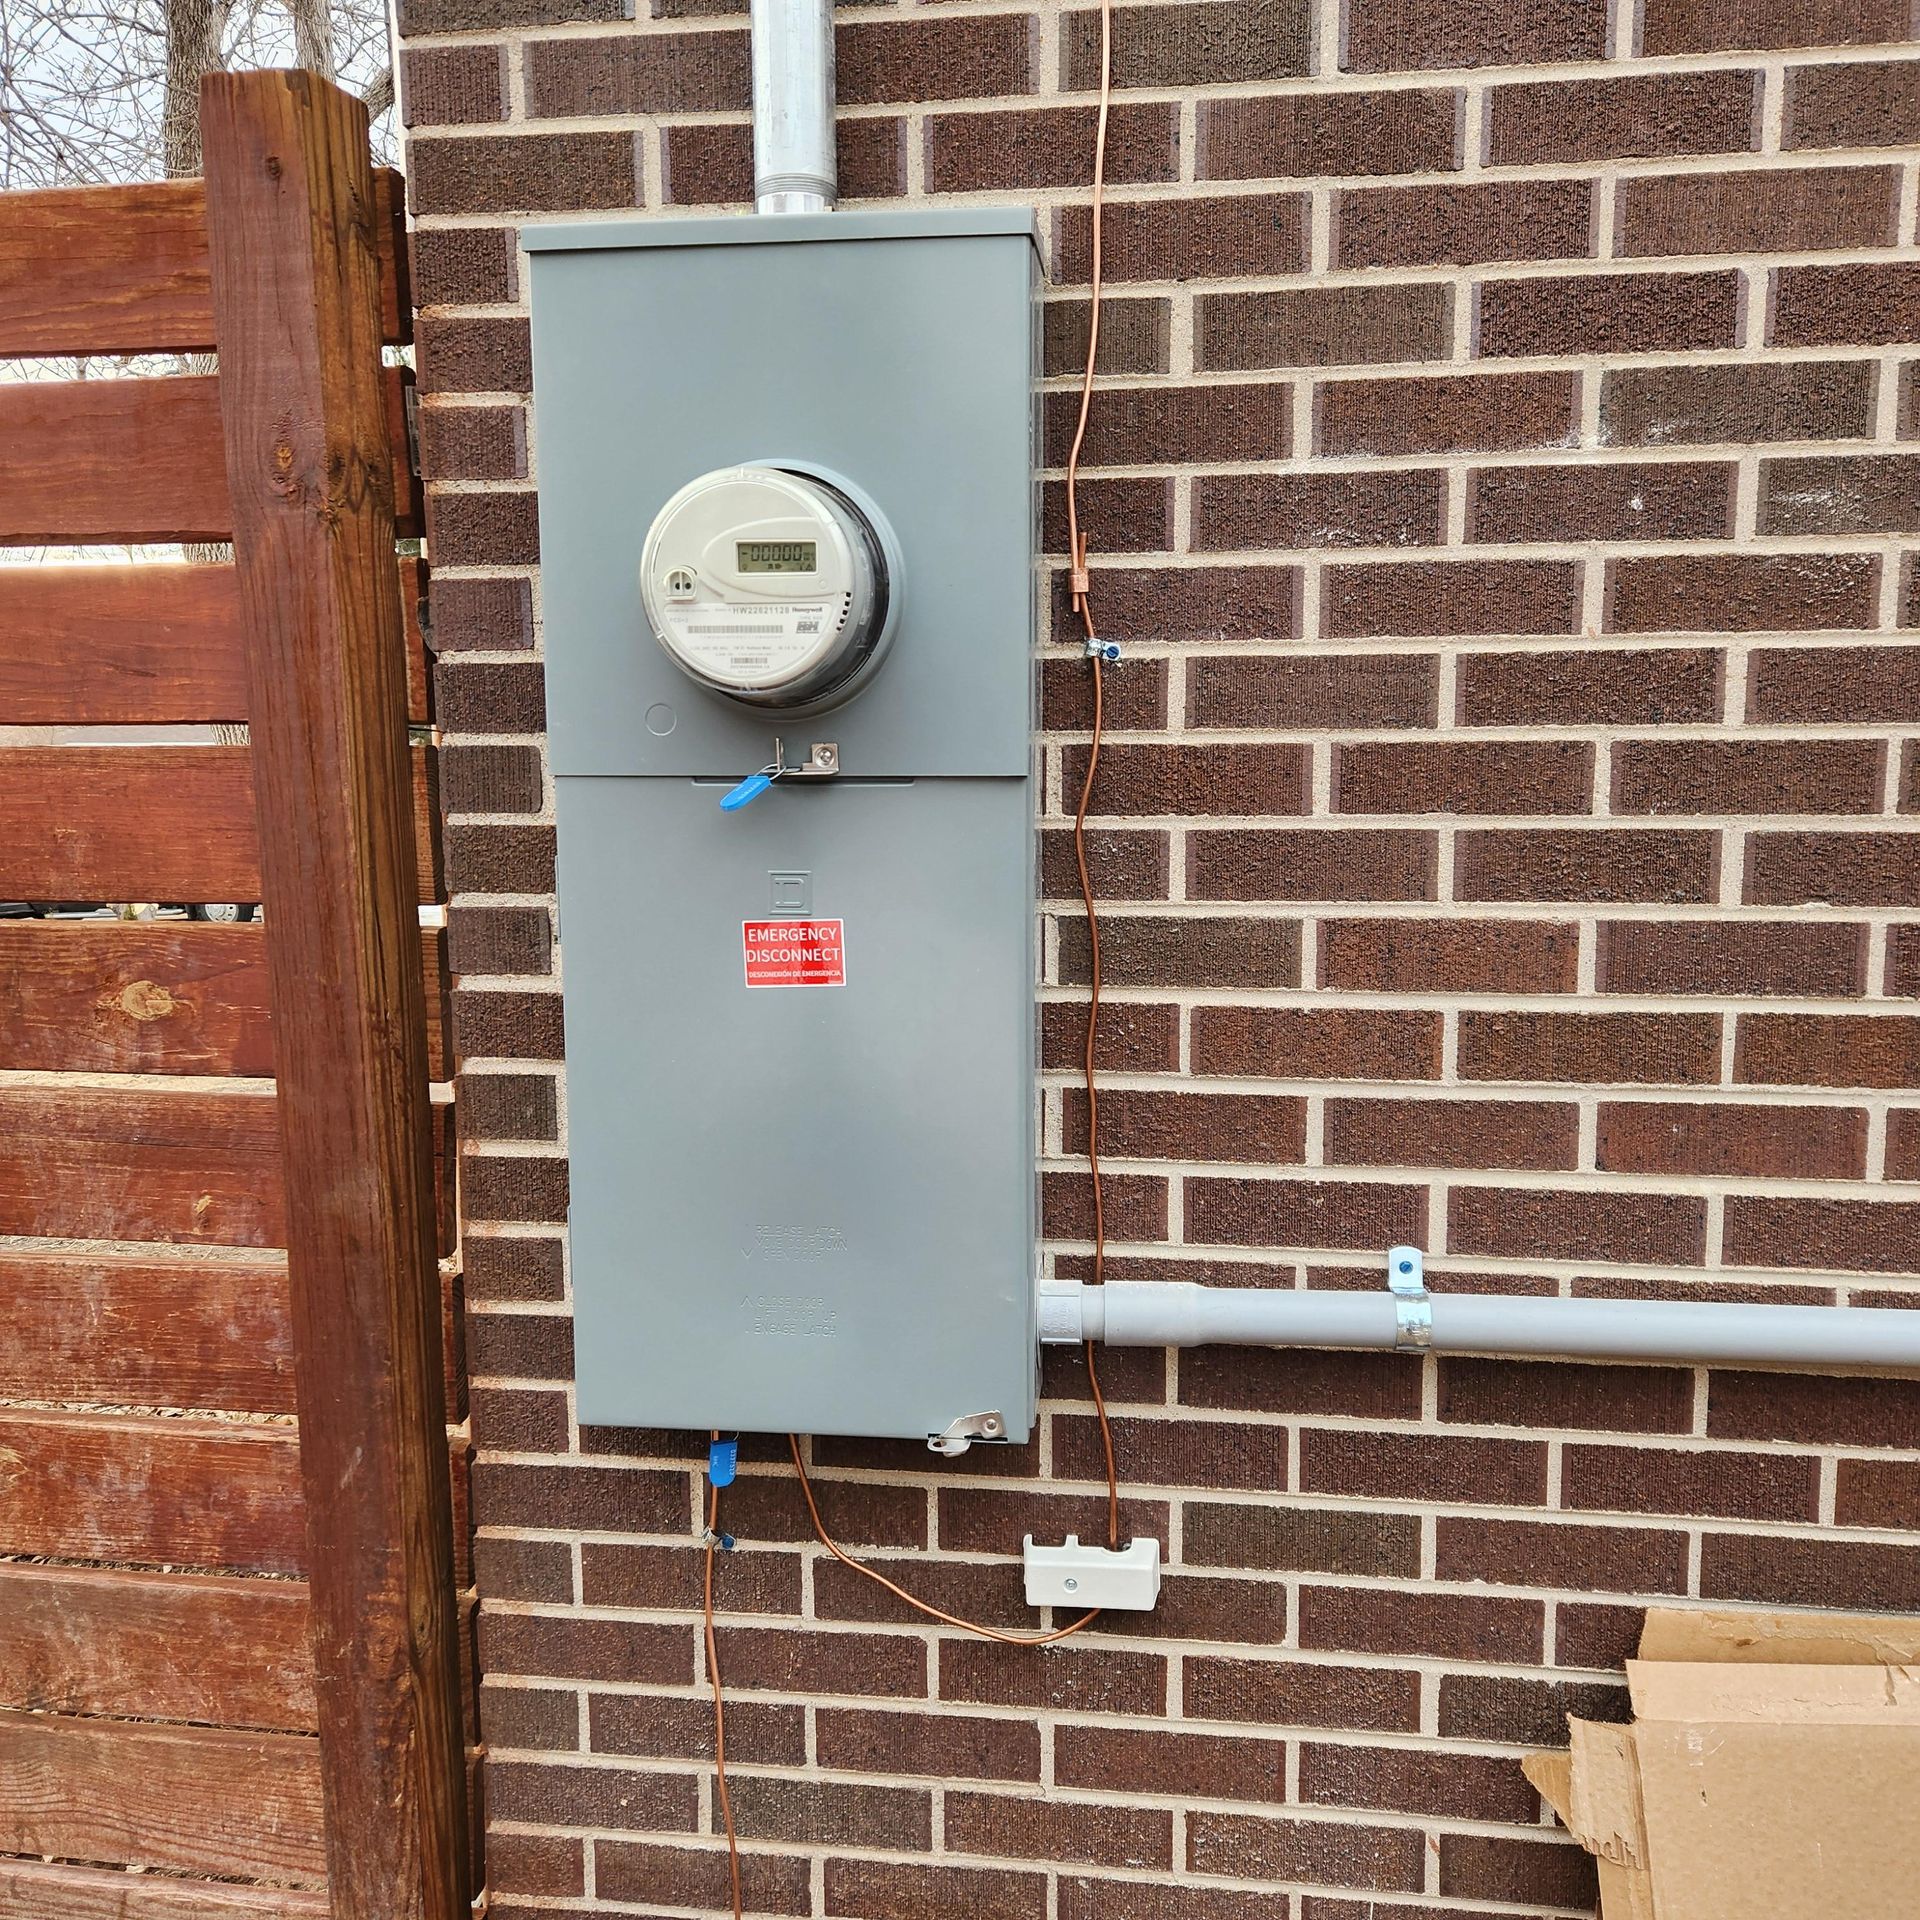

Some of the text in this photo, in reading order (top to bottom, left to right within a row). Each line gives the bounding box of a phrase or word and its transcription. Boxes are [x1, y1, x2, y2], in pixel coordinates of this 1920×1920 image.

[748, 927, 837, 942] EMERGENCY
[746, 947, 840, 963] DISCONNECT
[802, 969, 841, 977] EMERGENCIA
